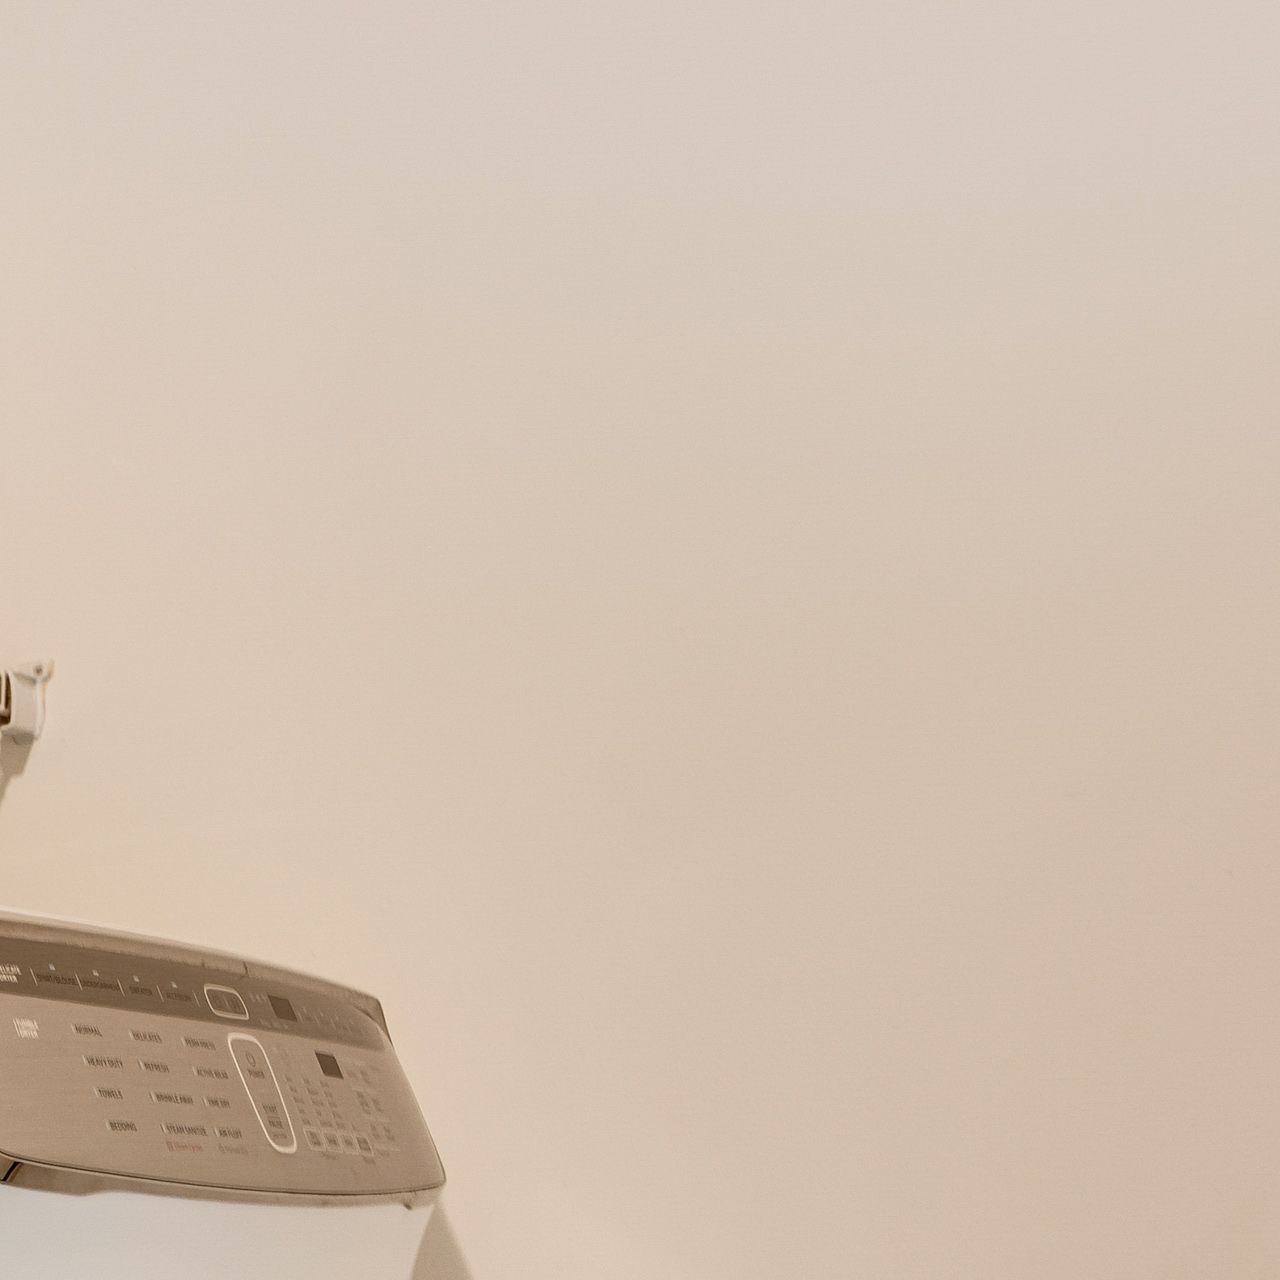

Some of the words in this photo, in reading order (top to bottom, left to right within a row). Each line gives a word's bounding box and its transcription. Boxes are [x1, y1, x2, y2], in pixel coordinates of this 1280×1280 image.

[75, 1023, 103, 1037] NORMAL
[132, 1030, 162, 1043] DELICATES
[86, 1055, 107, 1068] HEAVY
[107, 1057, 123, 1068] DUTY
[98, 1088, 123, 1100] TOWELS
